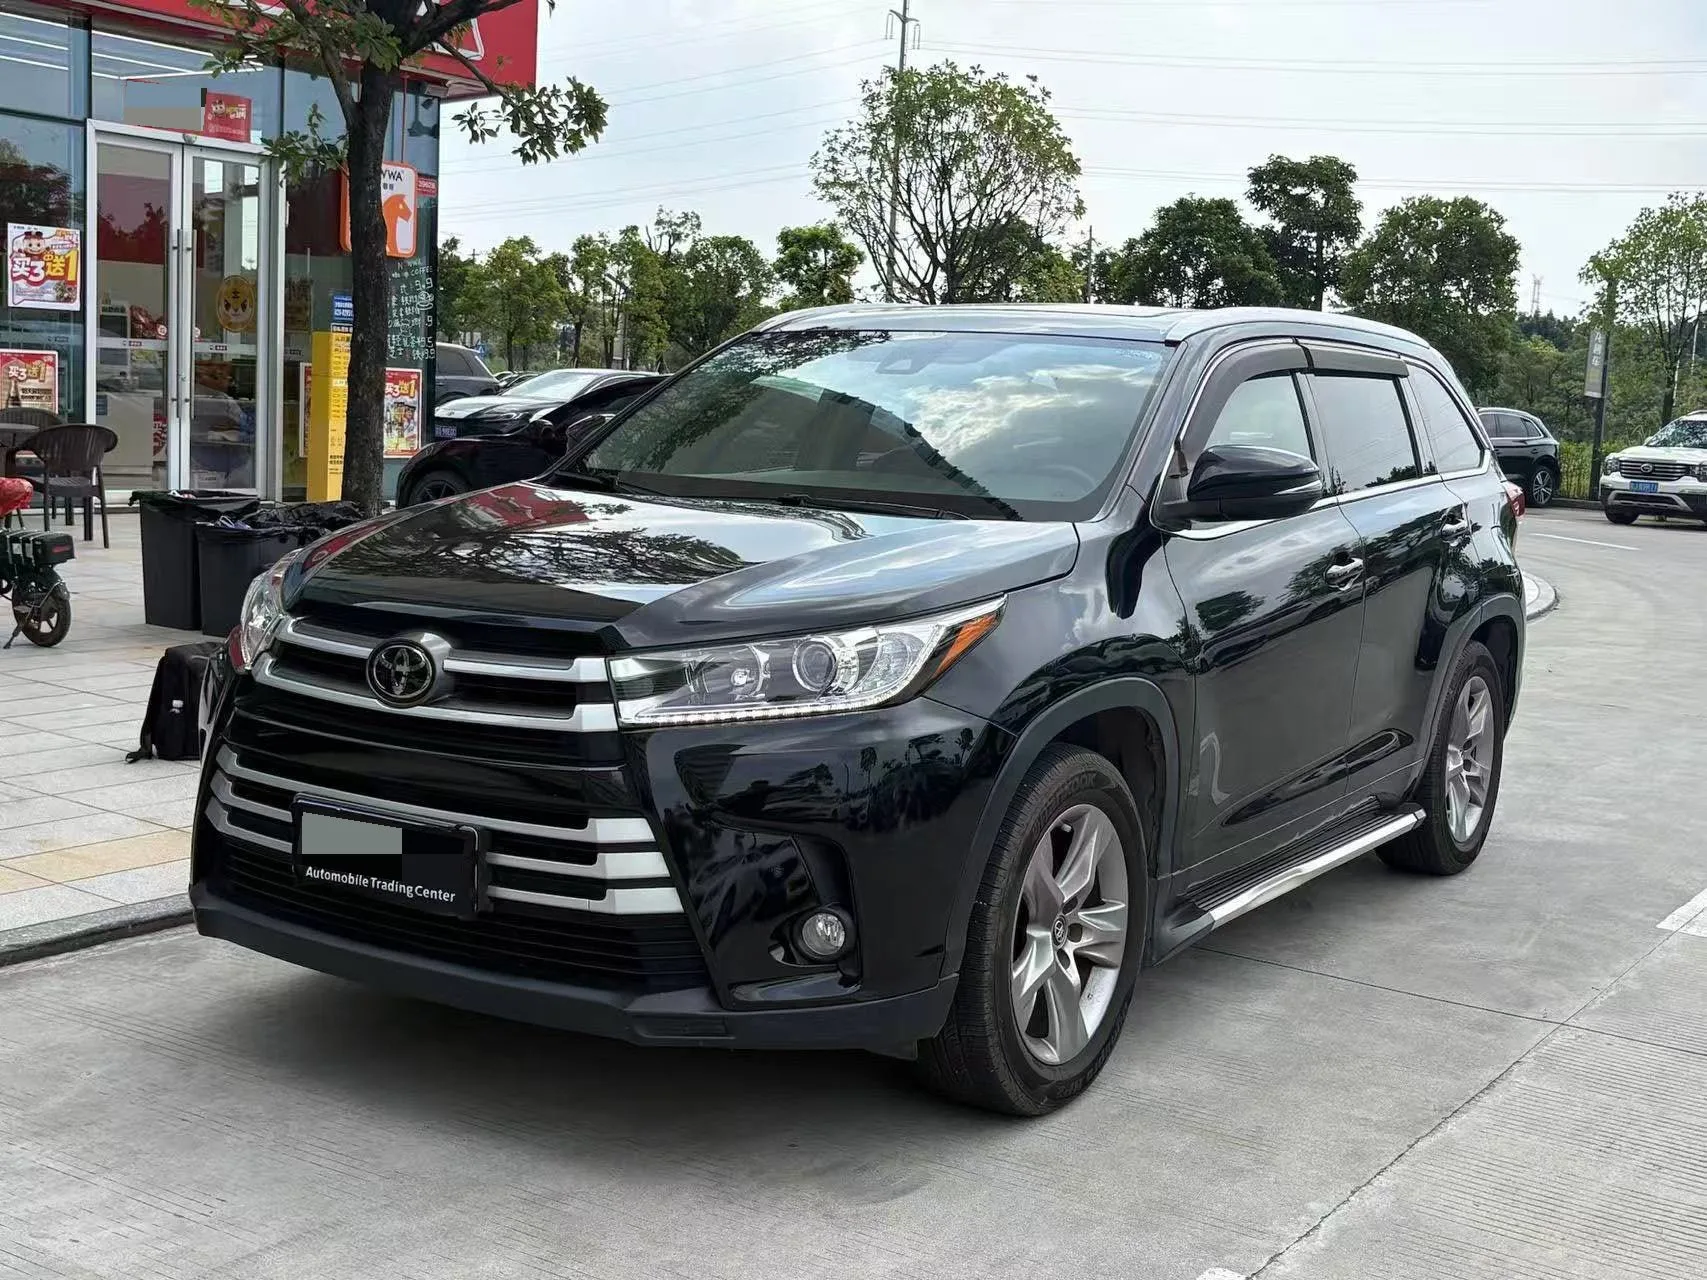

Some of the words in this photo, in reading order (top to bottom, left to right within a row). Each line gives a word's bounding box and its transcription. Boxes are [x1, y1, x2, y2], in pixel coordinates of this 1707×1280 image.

[12, 249, 78, 284] 买3送1
[305, 866, 369, 888] Automobile
[370, 876, 414, 898] Trading
[414, 885, 456, 902] Center
